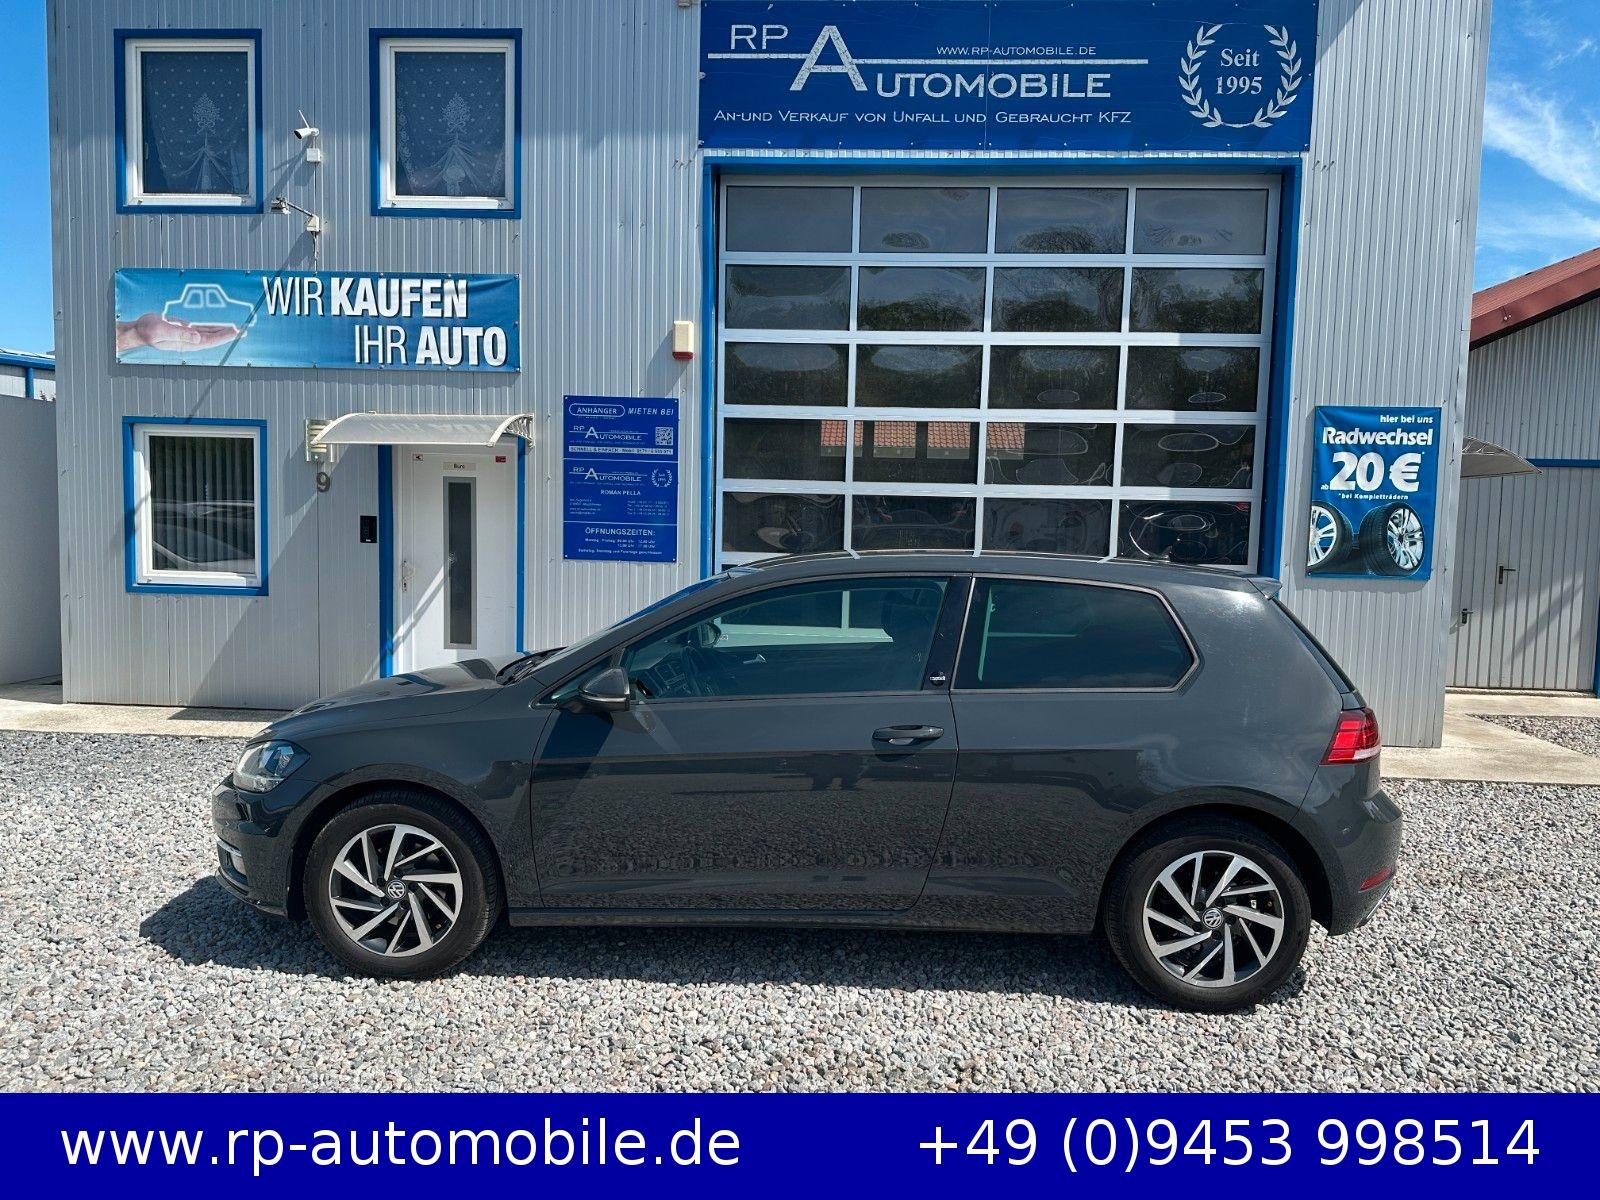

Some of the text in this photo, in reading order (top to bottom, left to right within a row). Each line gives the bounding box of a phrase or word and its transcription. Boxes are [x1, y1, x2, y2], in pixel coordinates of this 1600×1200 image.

[730, 24, 789, 50] RP
[1220, 48, 1260, 67] Seit
[1216, 76, 1263, 95] 1995
[1098, 111, 1132, 123] KFZ
[262, 276, 467, 318] WIR KAUFEN
[354, 324, 507, 366] IHR AUTO
[628, 407, 657, 415] MIETEN
[660, 408, 674, 416] BEI
[1380, 414, 1433, 424] hier bei uns
[1322, 426, 1433, 446] Radwechsel
[1329, 451, 1385, 492] 20
[316, 472, 331, 493] 9
